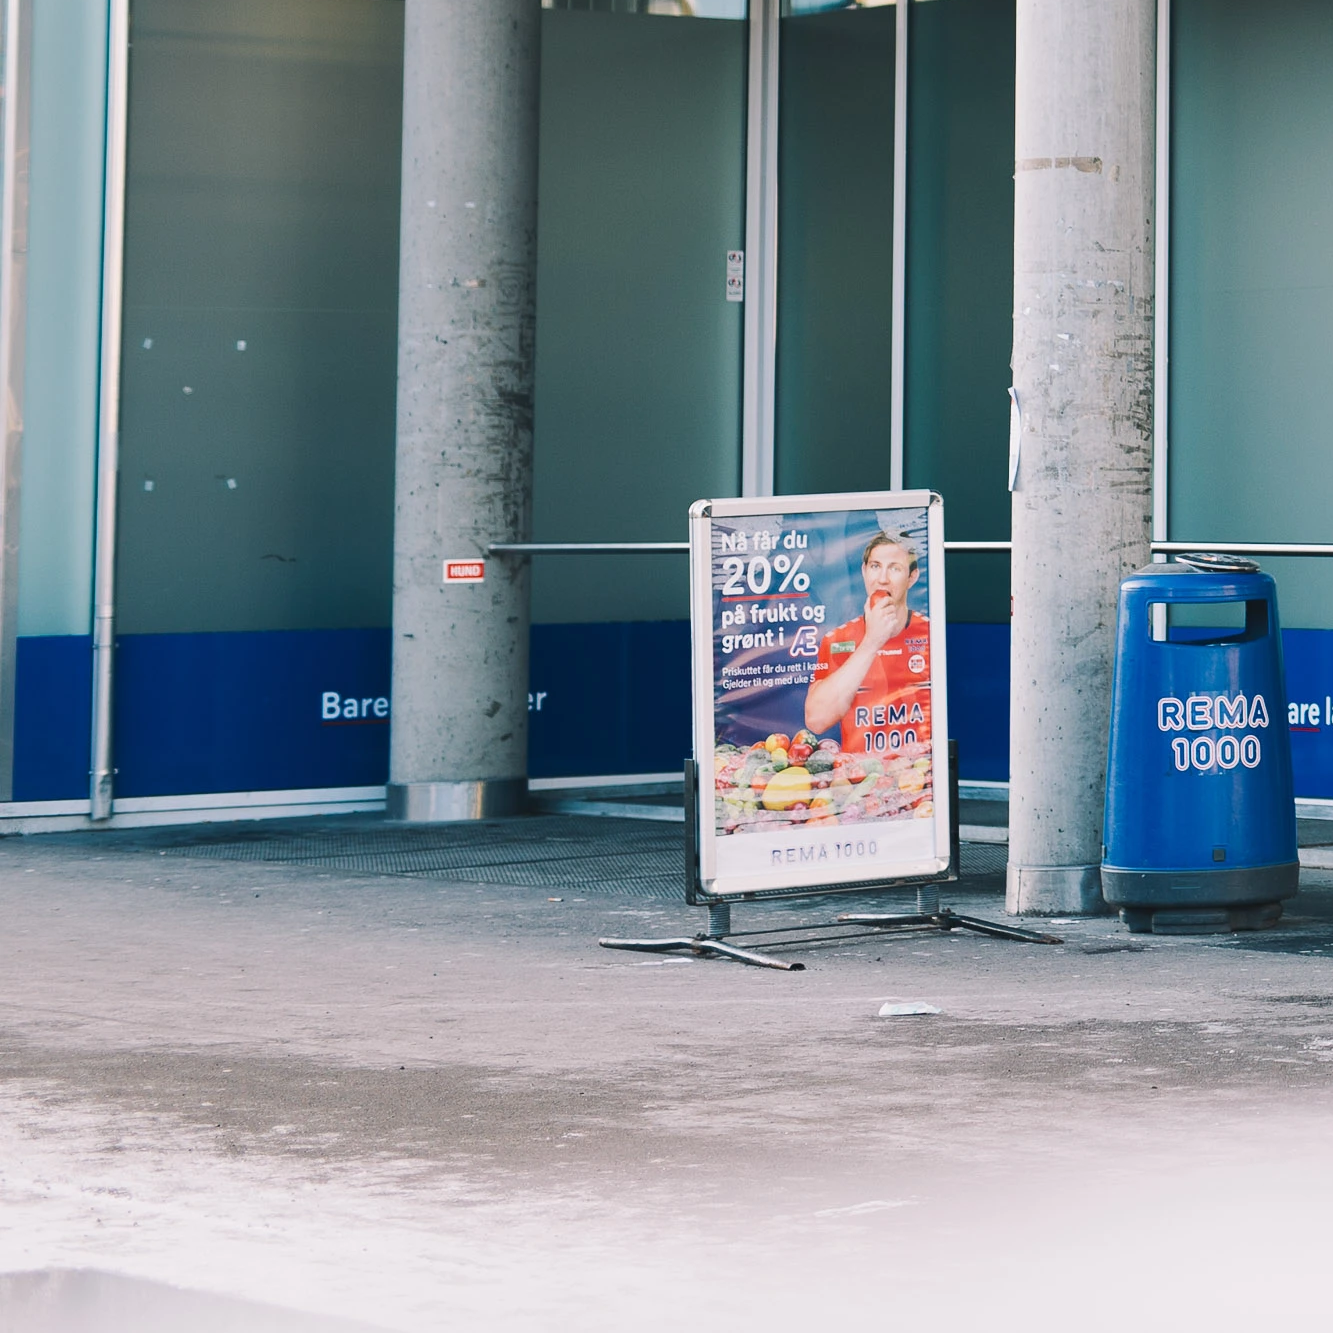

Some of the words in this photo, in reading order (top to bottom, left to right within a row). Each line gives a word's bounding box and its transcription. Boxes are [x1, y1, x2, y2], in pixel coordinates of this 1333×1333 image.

[721, 531, 747, 552] Nå
[752, 531, 780, 550] får
[783, 530, 807, 549] du
[450, 565, 480, 577] HUND
[722, 554, 810, 596] 20%
[722, 604, 745, 629] på
[750, 603, 798, 623] frukt
[802, 604, 825, 623] og
[722, 629, 774, 653] grønt
[779, 627, 784, 645] i
[790, 626, 819, 657] Æ
[722, 666, 761, 676] Priskuttet
[763, 665, 773, 673] får
[775, 664, 785, 673] du
[787, 663, 801, 671] rett
[807, 661, 828, 670] kassa
[723, 679, 751, 690] Gjelder
[753, 677, 761, 686] til
[764, 678, 773, 687] og
[775, 675, 793, 685] med
[794, 674, 809, 684] uke
[810, 674, 815, 683] 5
[320, 690, 389, 720] Bare
[855, 702, 925, 728] REMA
[1157, 694, 1269, 732] REMA
[1288, 701, 1320, 727] are
[864, 730, 917, 753] 1000
[1171, 734, 1262, 772] 1000
[771, 844, 828, 866] REMA
[835, 840, 879, 859] 1000
